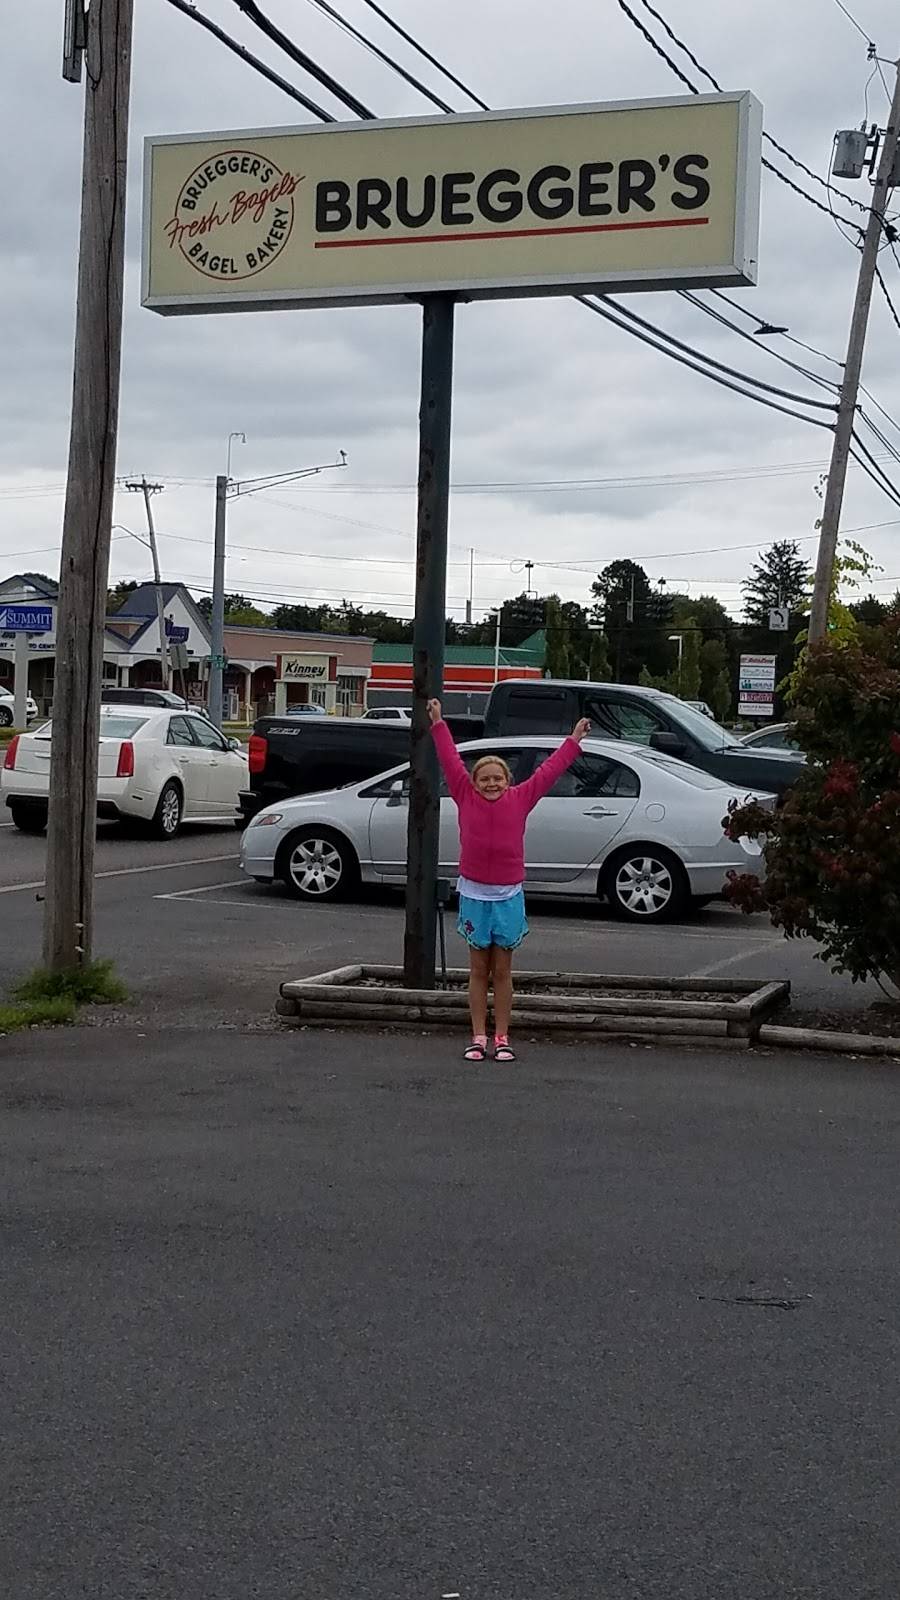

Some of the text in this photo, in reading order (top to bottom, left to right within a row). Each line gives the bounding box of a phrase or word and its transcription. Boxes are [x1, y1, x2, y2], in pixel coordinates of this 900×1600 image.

[163, 172, 306, 249] Fresh Bagels
[181, 156, 274, 211] BRUEGGER'S
[315, 154, 710, 232] BRUEGGER'S
[188, 207, 289, 274] BAGEL BAKERY
[7, 612, 52, 624] SUMMIT
[285, 662, 326, 676] Kinney
